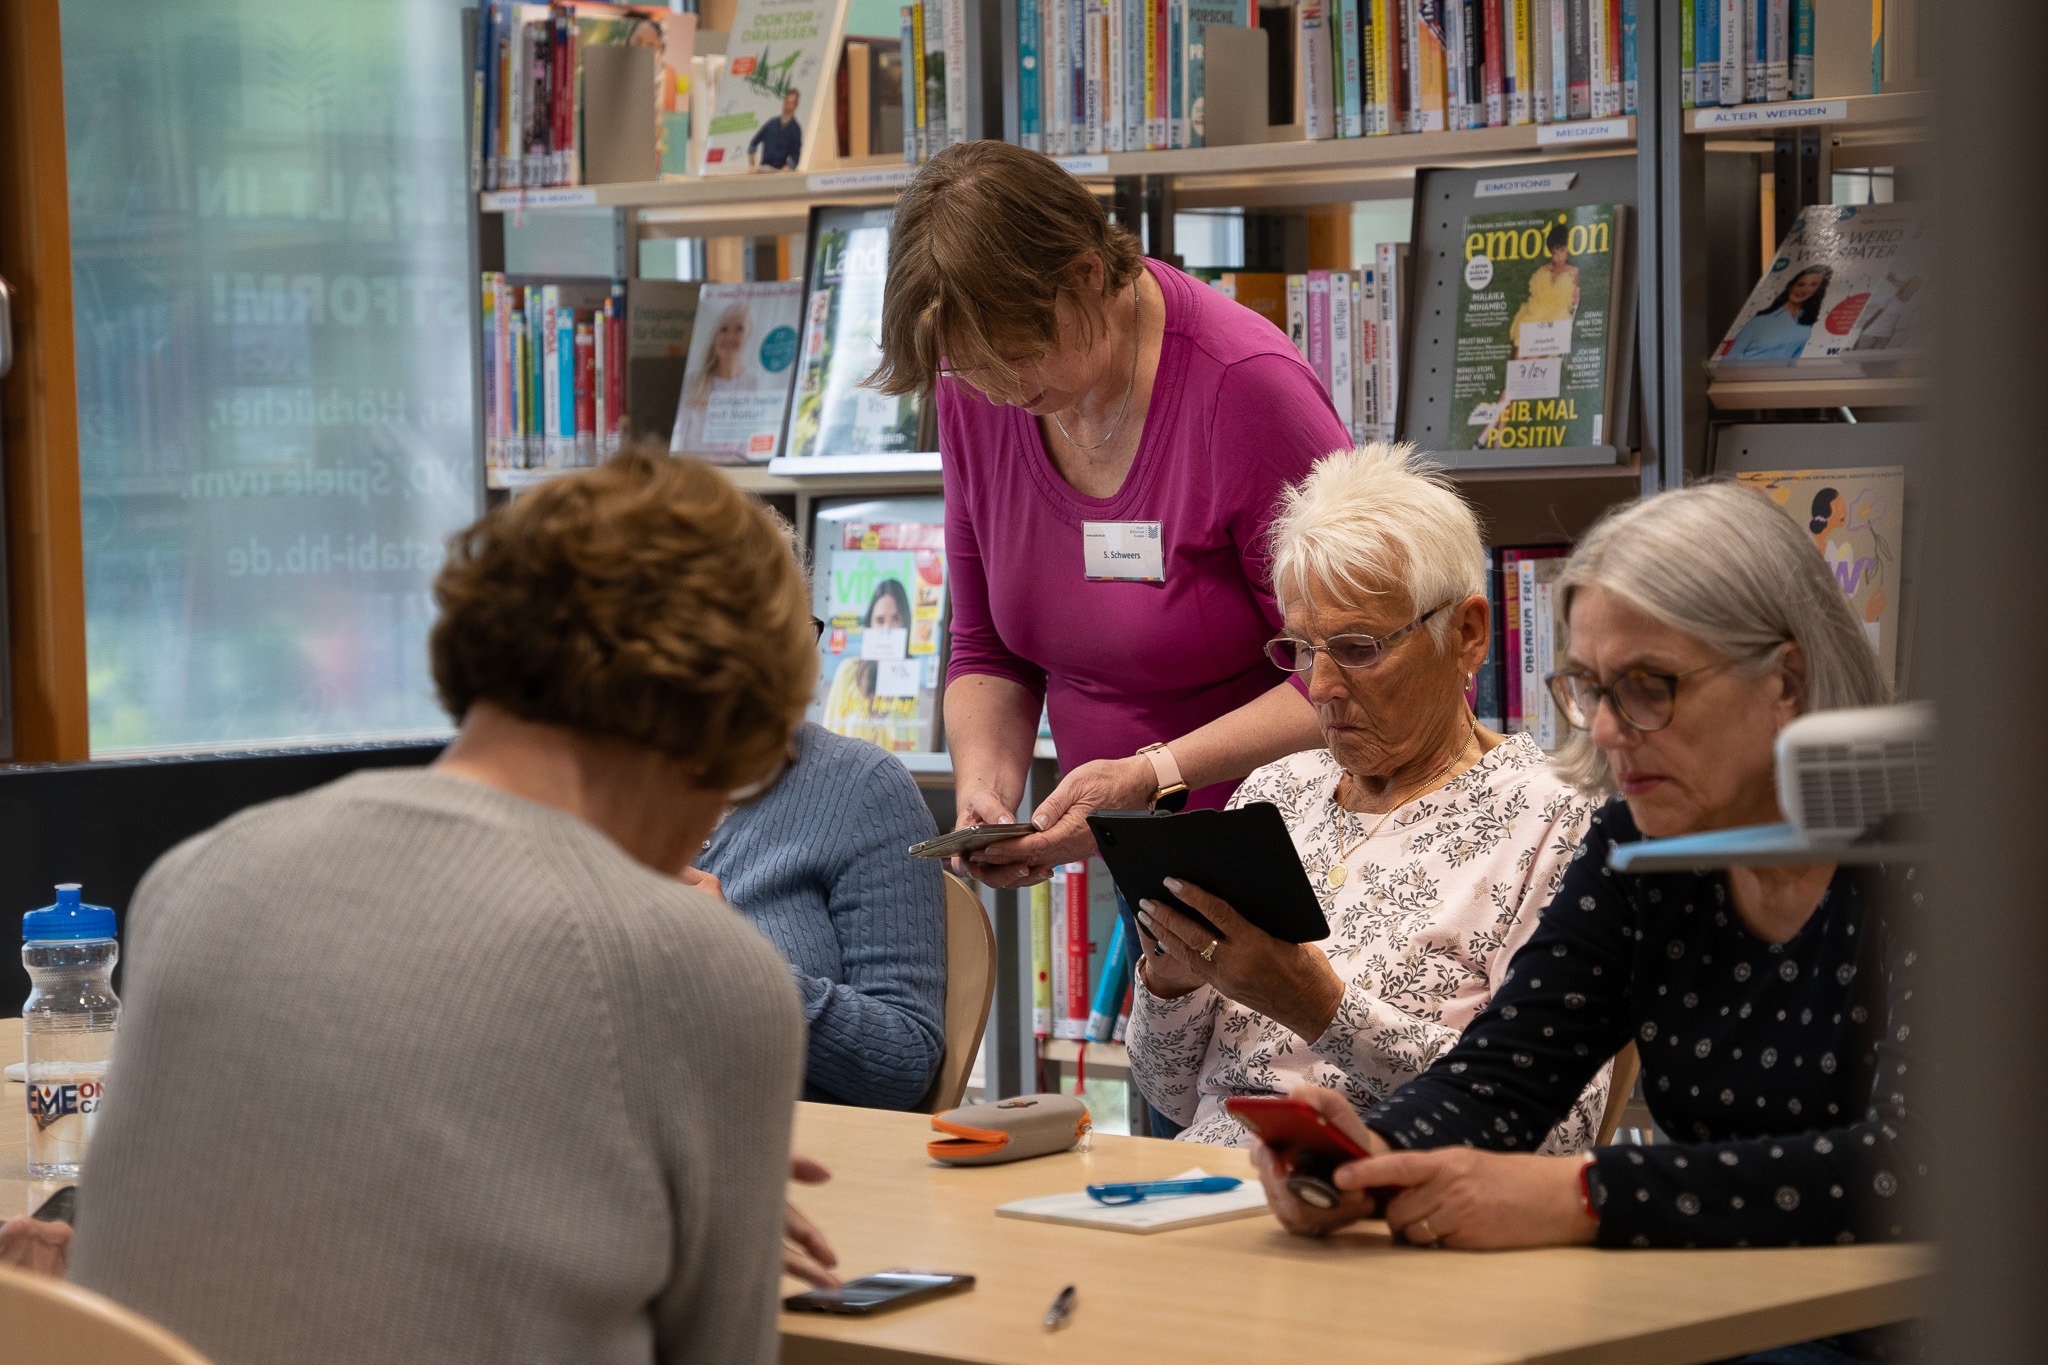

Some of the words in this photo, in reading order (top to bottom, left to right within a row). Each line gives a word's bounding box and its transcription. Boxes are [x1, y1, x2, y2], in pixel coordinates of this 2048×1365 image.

[1714, 111, 1758, 122] ALTER
[1766, 107, 1827, 118] WERDEN
[1556, 126, 1609, 138] MEDIZIN
[1485, 179, 1551, 192] EMOTIONS
[1519, 361, 1548, 379] 7/24
[1537, 399, 1578, 421] MAL
[1487, 425, 1567, 449] POSITIV
[1103, 550, 1110, 559] S.
[1110, 550, 1141, 560] Schweers
[1523, 607, 1535, 674] OBENRUM
